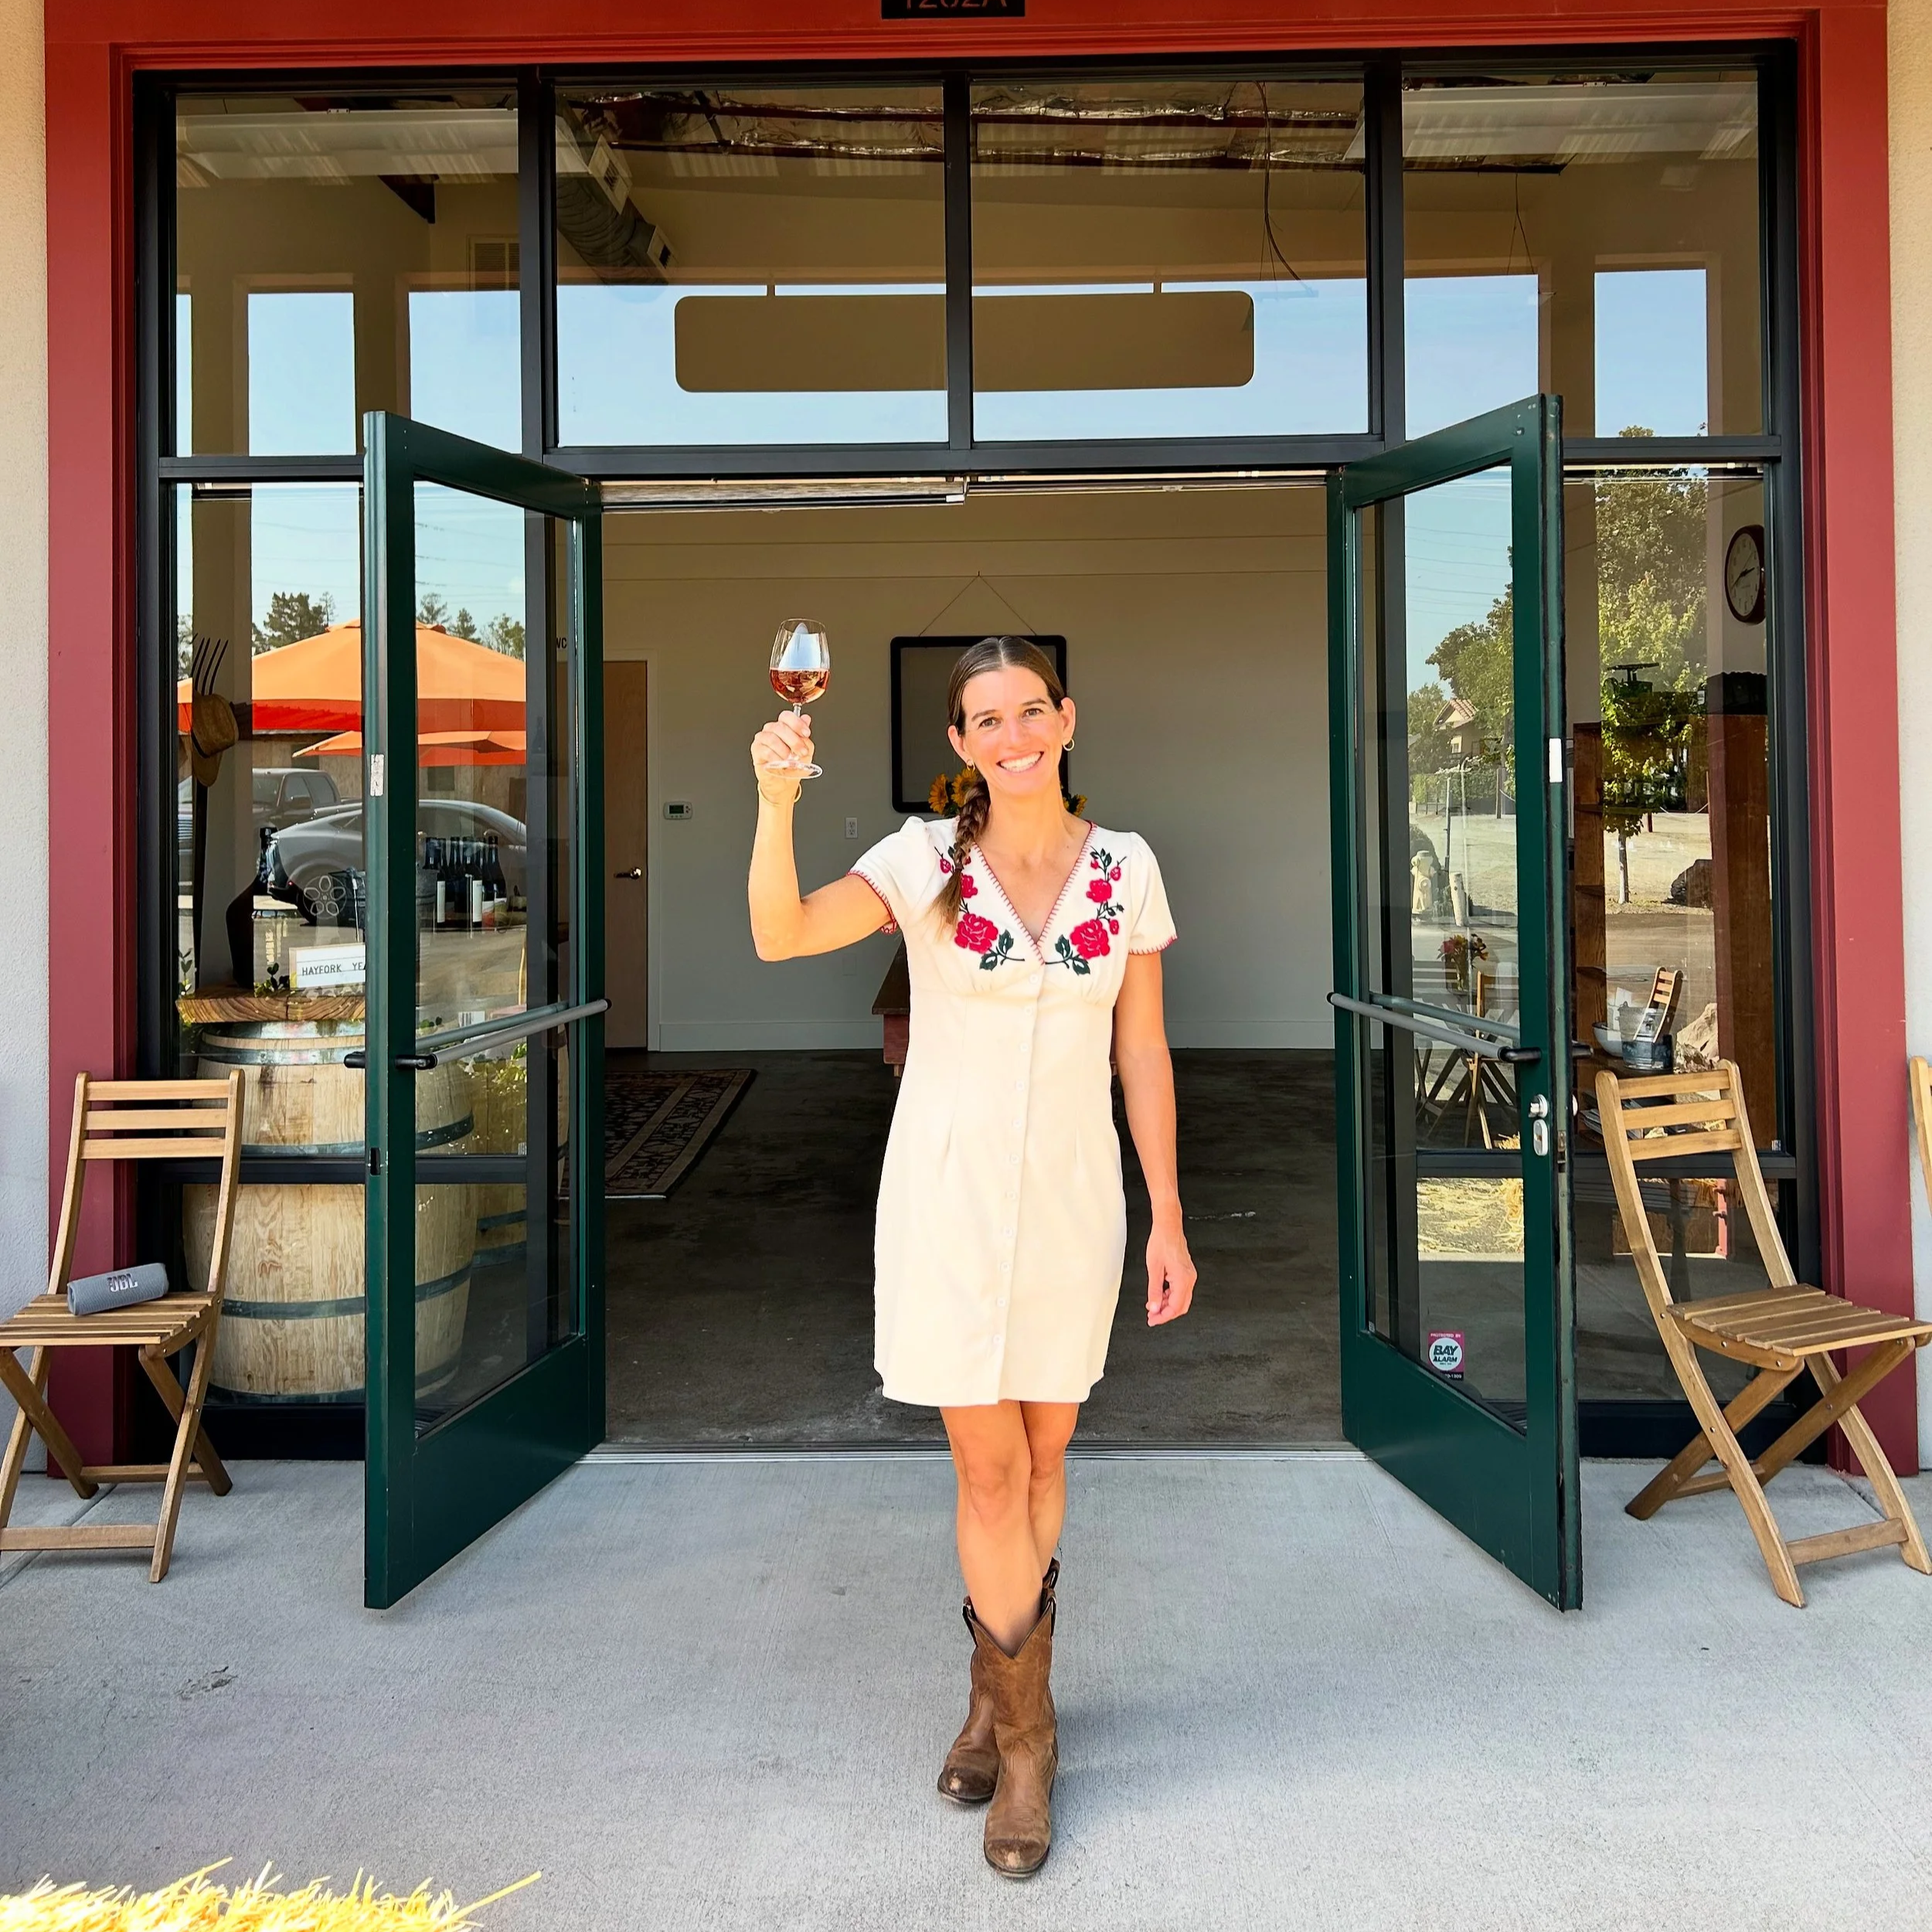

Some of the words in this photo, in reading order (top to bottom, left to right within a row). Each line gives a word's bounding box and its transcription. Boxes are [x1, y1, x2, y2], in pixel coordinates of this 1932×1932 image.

[302, 964, 342, 976] HAYFORK
[352, 961, 366, 971] YE
[107, 1273, 138, 1292] JBL
[1433, 1345, 1459, 1355] BAY
